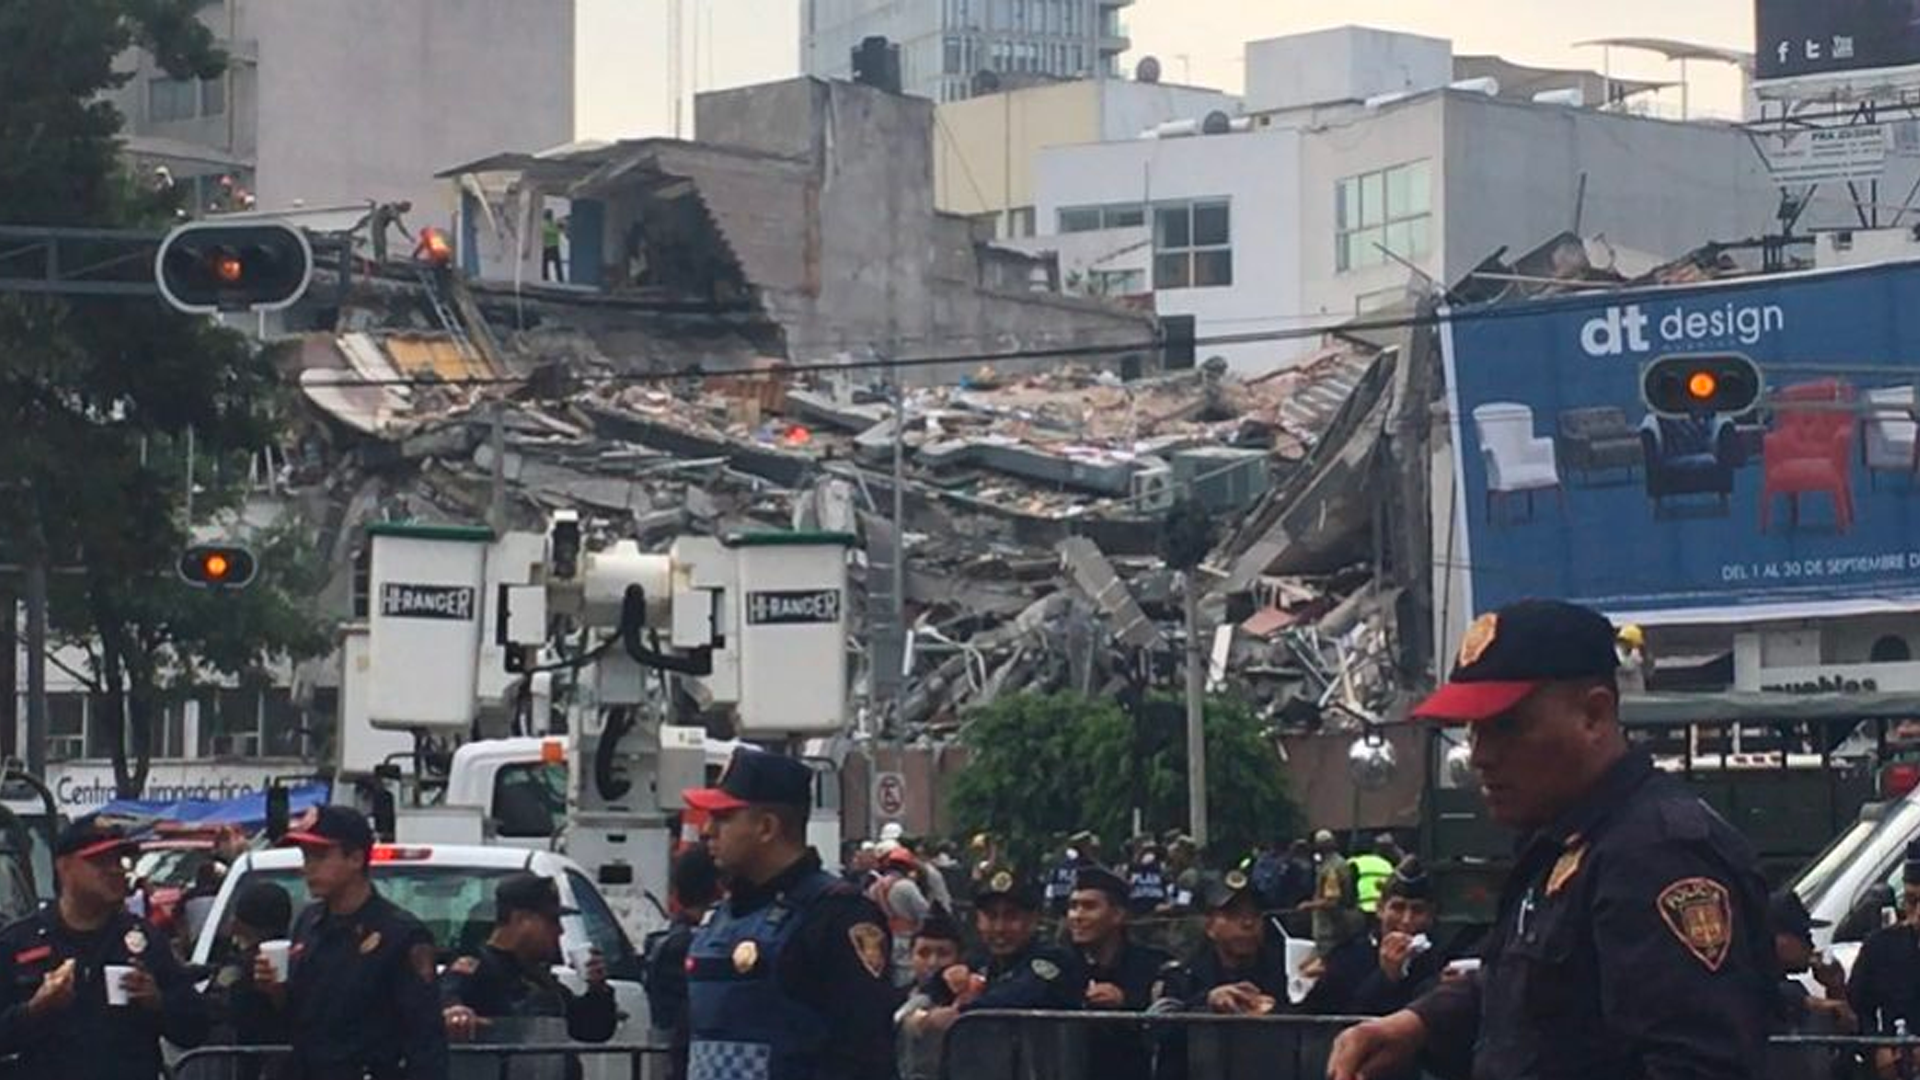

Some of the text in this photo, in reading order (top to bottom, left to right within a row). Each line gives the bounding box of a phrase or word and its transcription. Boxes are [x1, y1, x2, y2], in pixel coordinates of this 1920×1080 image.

[1580, 303, 1784, 357] dt design
[1722, 564, 1748, 581] DEL
[1763, 563, 1780, 578] AL
[1783, 561, 1800, 577] 30
[1804, 560, 1824, 576] DE
[1827, 554, 1904, 575] SEPTIEMBRE
